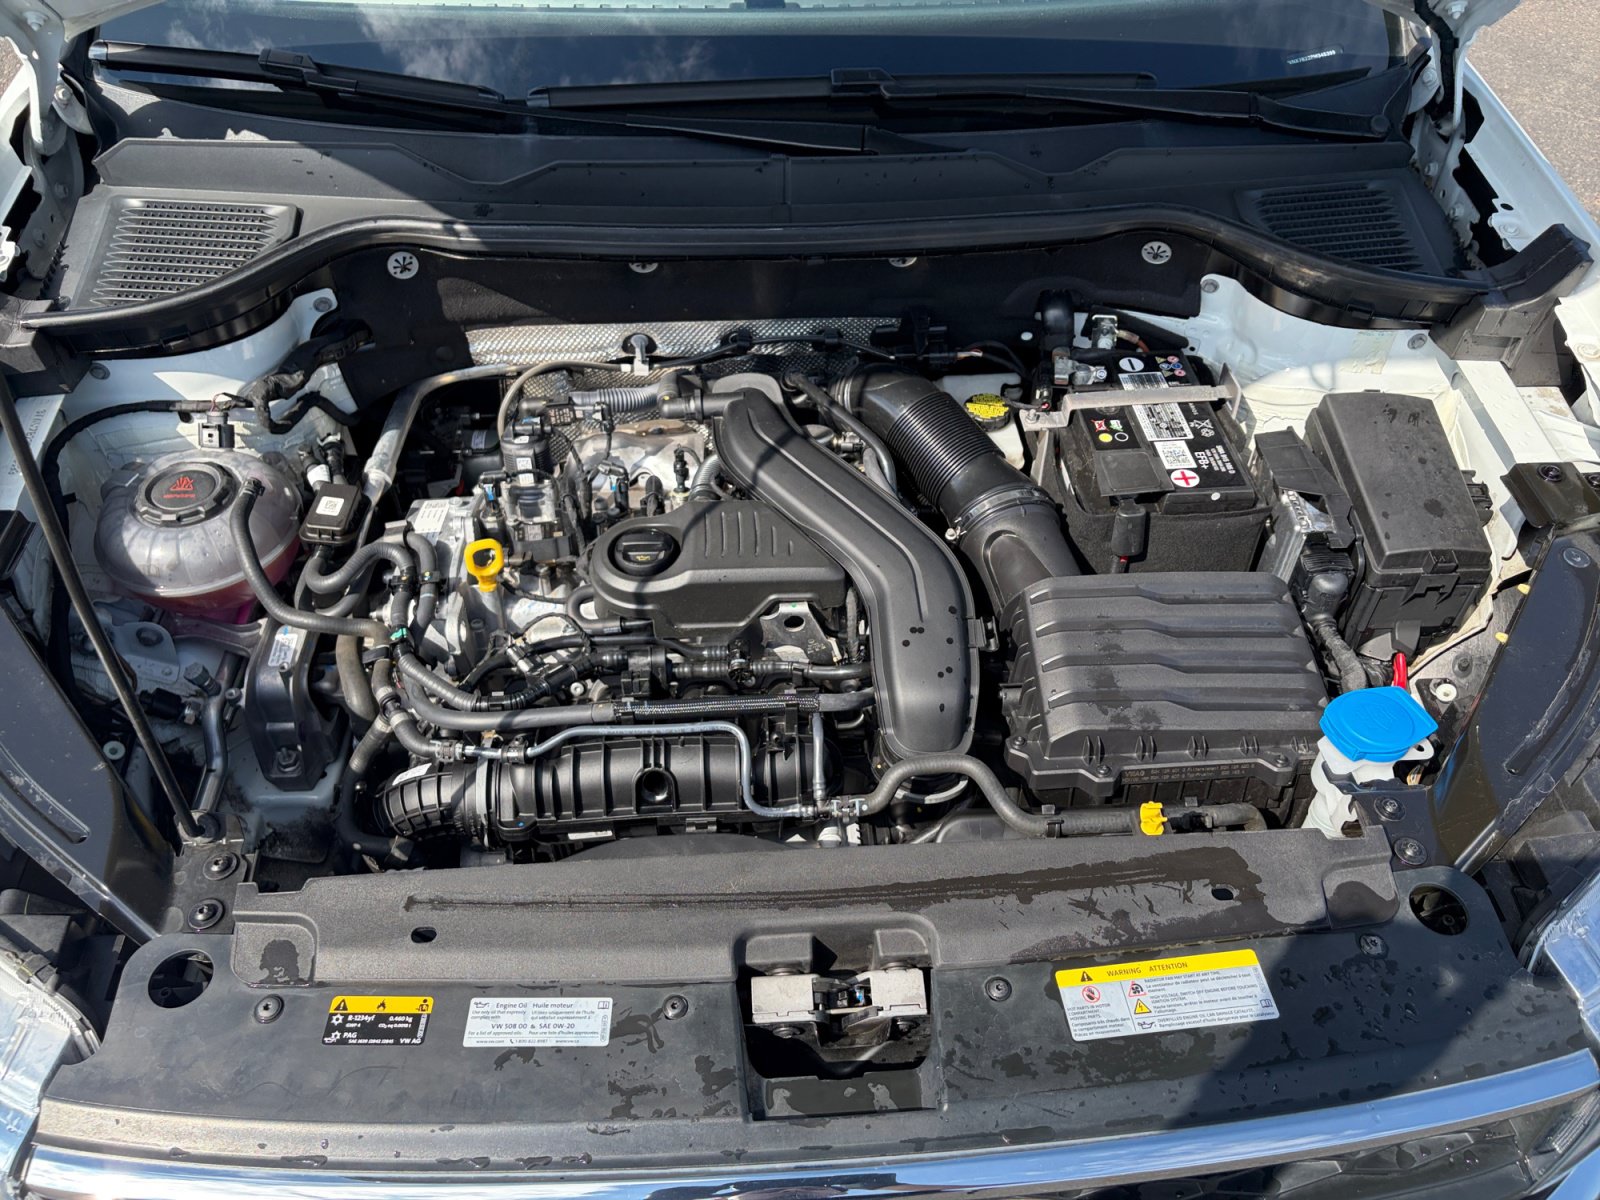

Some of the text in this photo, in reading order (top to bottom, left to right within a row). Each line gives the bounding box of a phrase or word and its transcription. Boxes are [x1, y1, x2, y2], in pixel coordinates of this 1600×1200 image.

[1195, 452, 1209, 469] EFB+
[1106, 962, 1188, 976] WARNING ATTENTION
